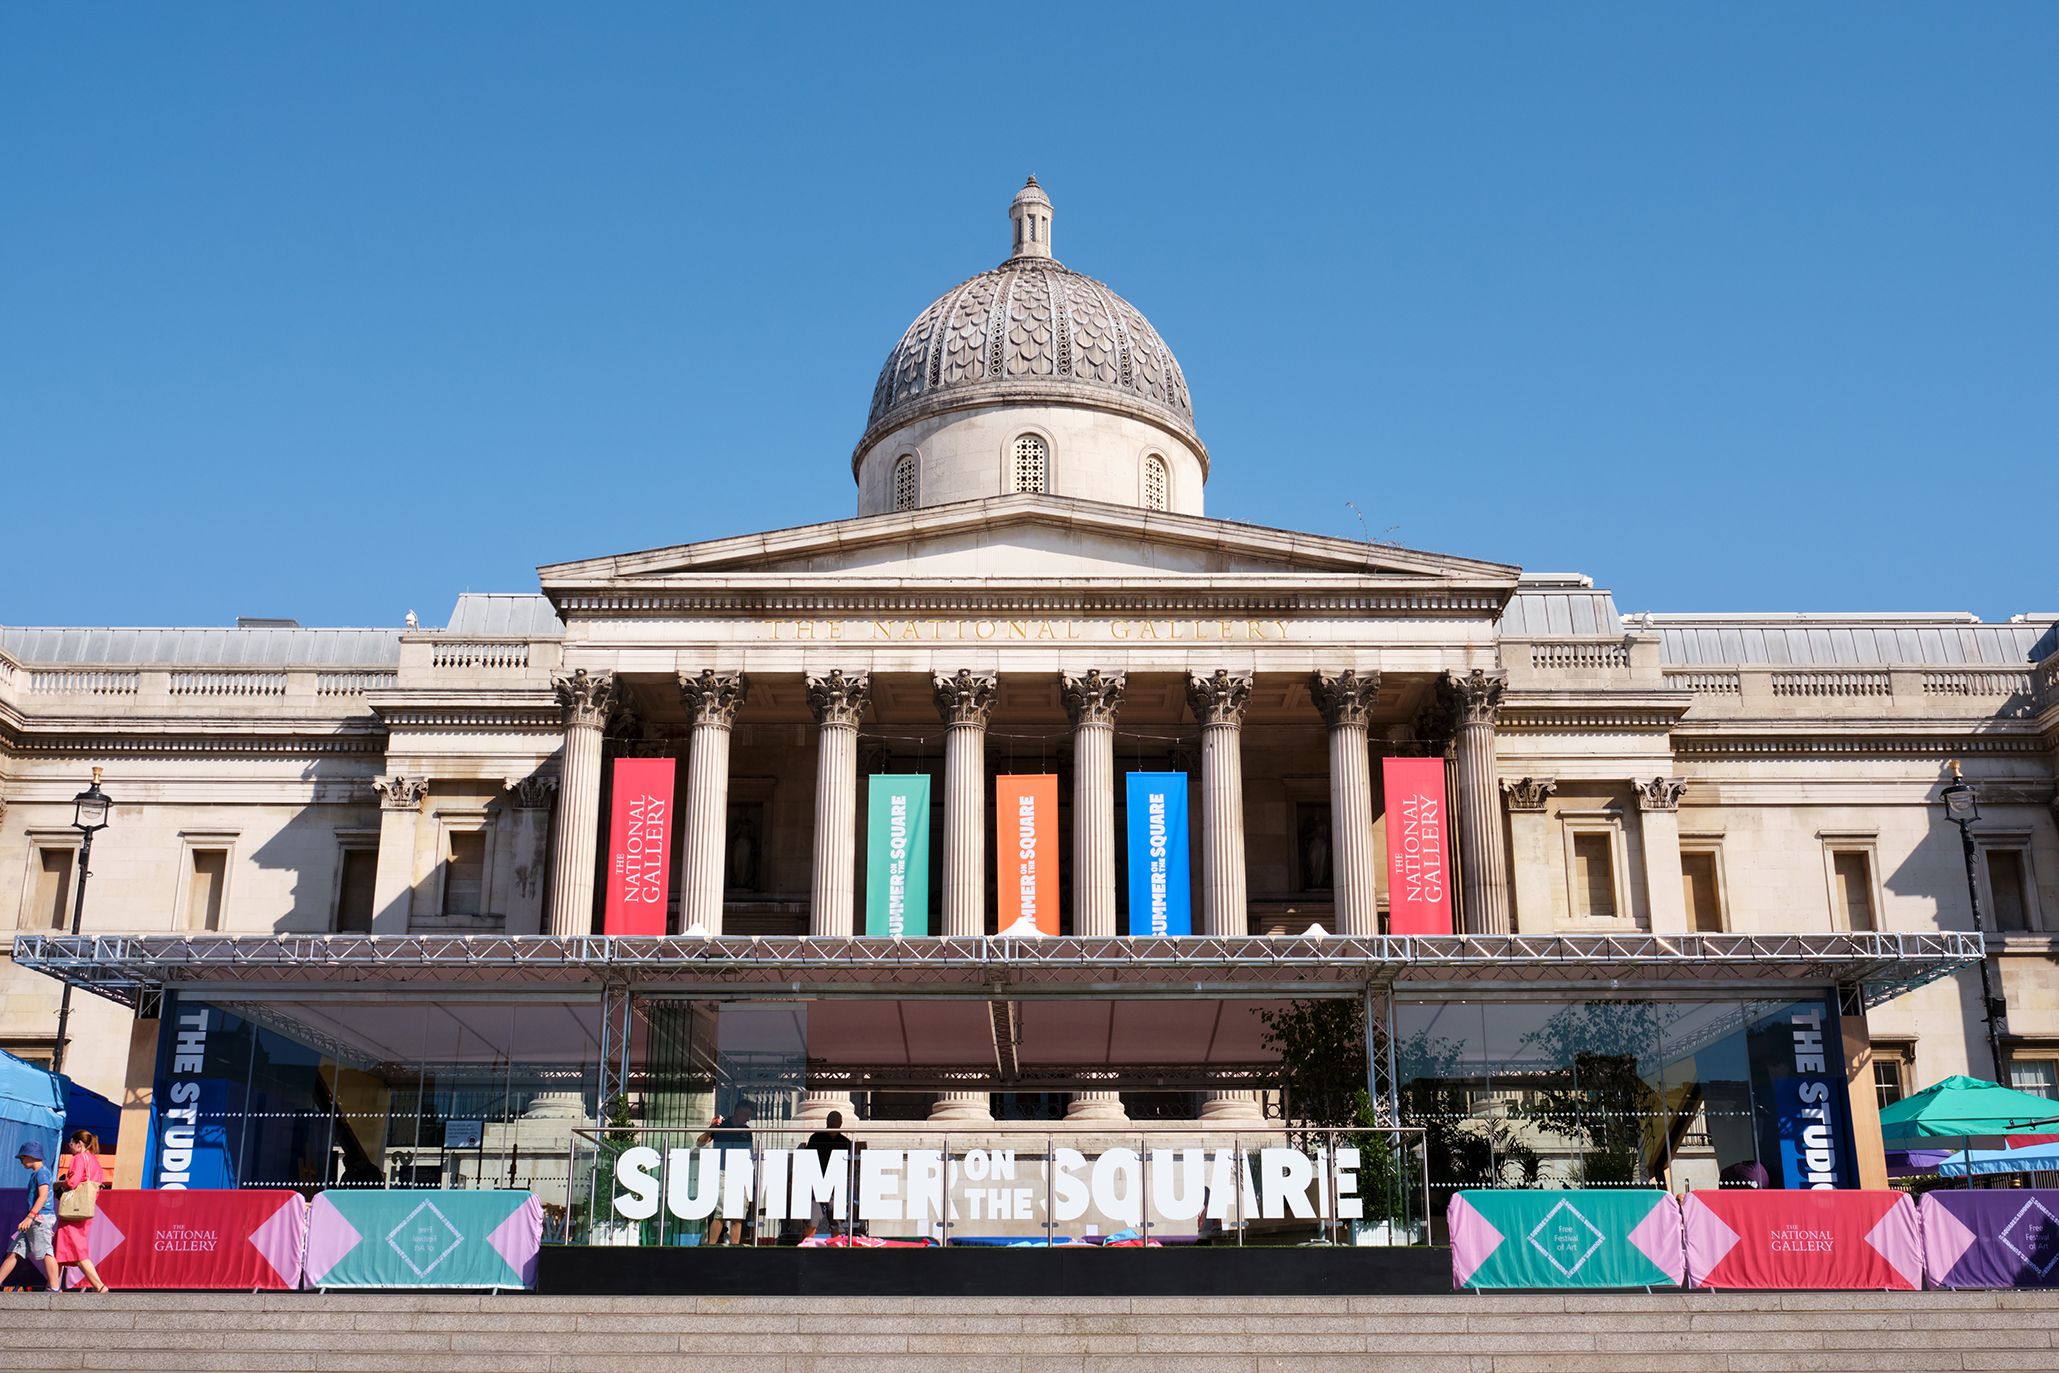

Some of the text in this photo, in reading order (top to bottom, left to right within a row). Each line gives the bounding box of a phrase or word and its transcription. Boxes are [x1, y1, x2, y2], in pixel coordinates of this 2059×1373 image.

[765, 620, 1290, 640] THE NATIONAL GALLERY
[890, 795, 907, 859] SQUARE
[1019, 795, 1037, 859] SQUARE
[1149, 793, 1167, 857] SQUARE
[616, 853, 625, 875] THE
[624, 795, 645, 903] NATIONAL
[642, 795, 665, 904] GALLERY
[890, 863, 898, 874] ON
[1020, 863, 1028, 874] ON
[1151, 861, 1158, 872] ON
[1395, 853, 1403, 875] THE
[1403, 794, 1422, 903] NATIONAL
[1420, 794, 1442, 903] GALLERY
[173, 1009, 209, 1073] THE
[1791, 1008, 1825, 1073] THE
[613, 1146, 1363, 1227] SUMMER ON THE SQUARE
[154, 1240, 217, 1251] GALLERY
[156, 1230, 218, 1239] NATIONAL
[1771, 1230, 1834, 1240] NATIONAL
[1771, 1240, 1834, 1251] GALLERY
